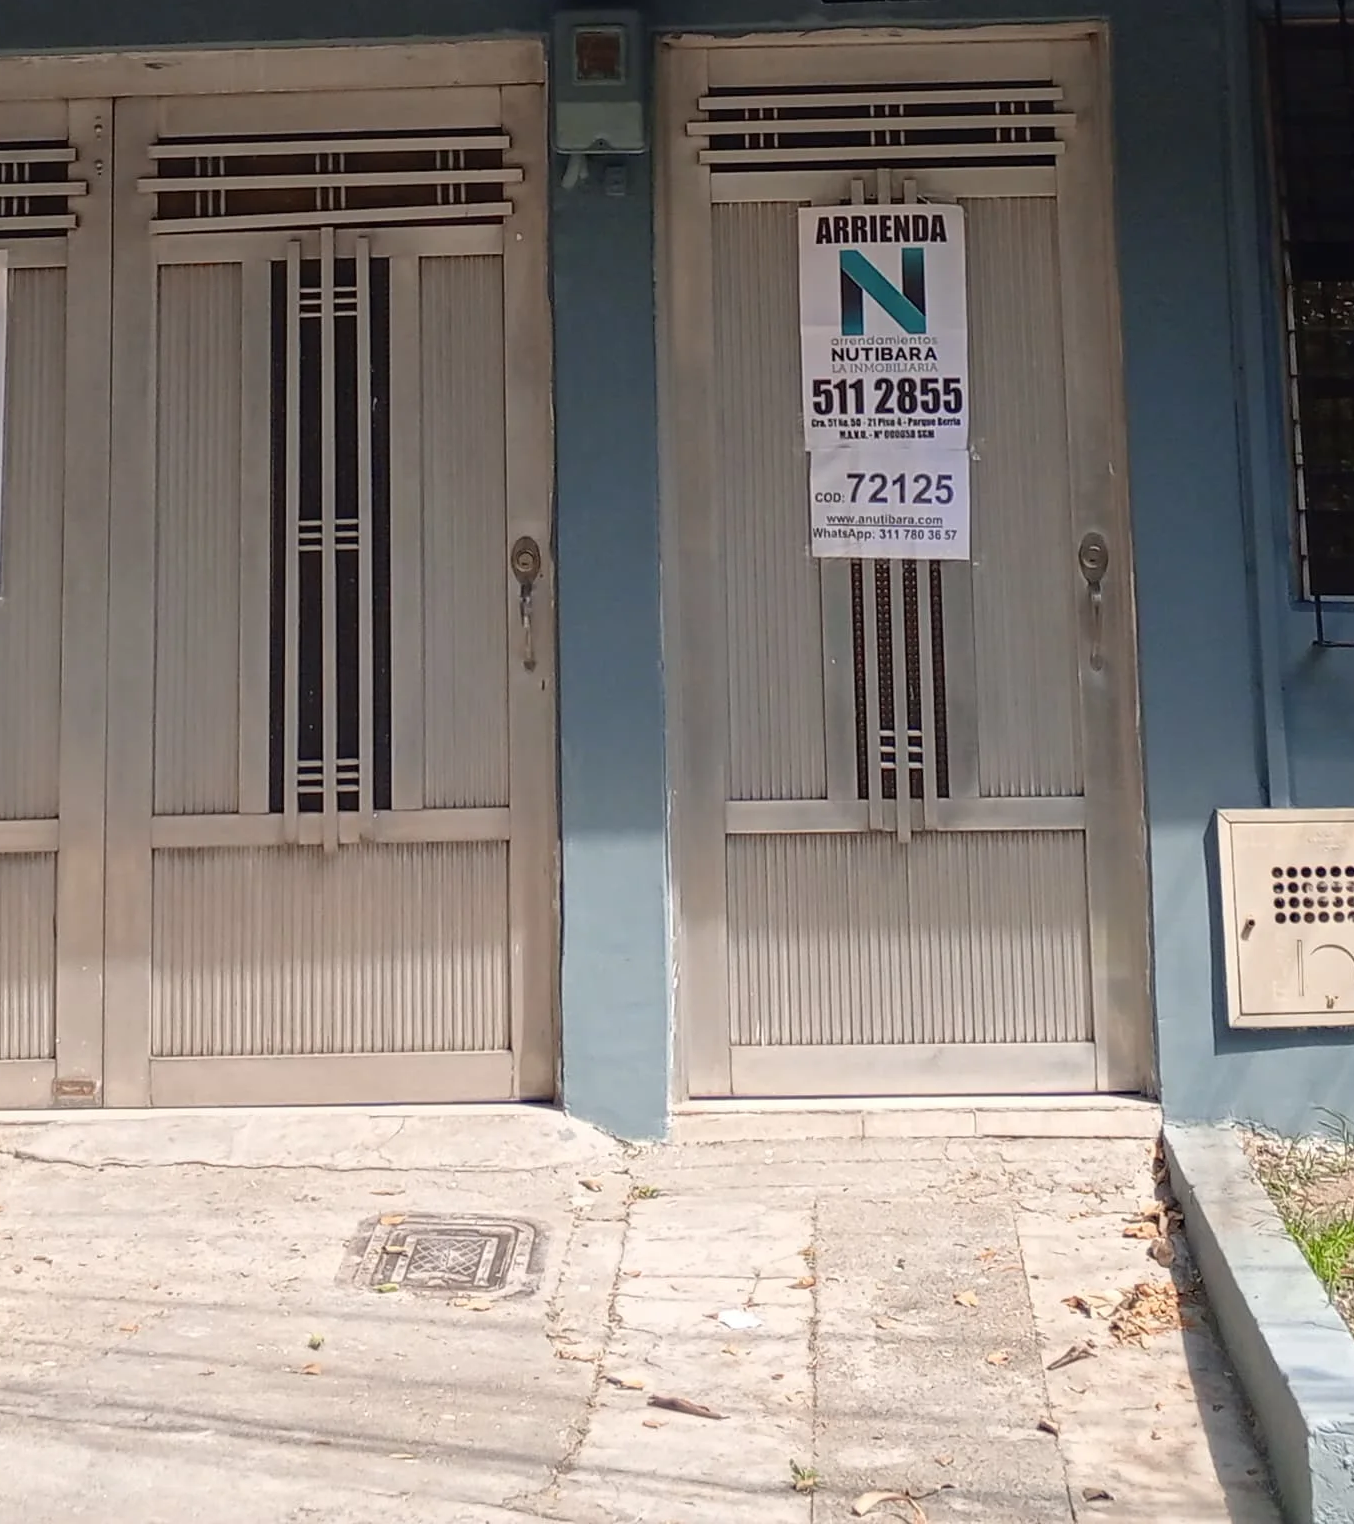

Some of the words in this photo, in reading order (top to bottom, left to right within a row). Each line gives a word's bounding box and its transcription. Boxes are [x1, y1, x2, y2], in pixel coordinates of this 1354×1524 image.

[816, 214, 947, 244] ARRIENDA
[839, 247, 927, 336] N
[831, 335, 938, 346] arrendamientos
[831, 346, 938, 362] NUTIBARA
[831, 363, 845, 374] LA
[849, 362, 938, 374] INMOBILIARIA
[815, 492, 845, 503] COD:
[847, 472, 954, 505] 72125
[826, 514, 943, 526] www.anutibara.com
[812, 528, 875, 541] WhatsApp:
[879, 529, 899, 540] 311
[903, 529, 925, 540] 780
[927, 530, 941, 540] 36
[945, 530, 957, 540] 57
